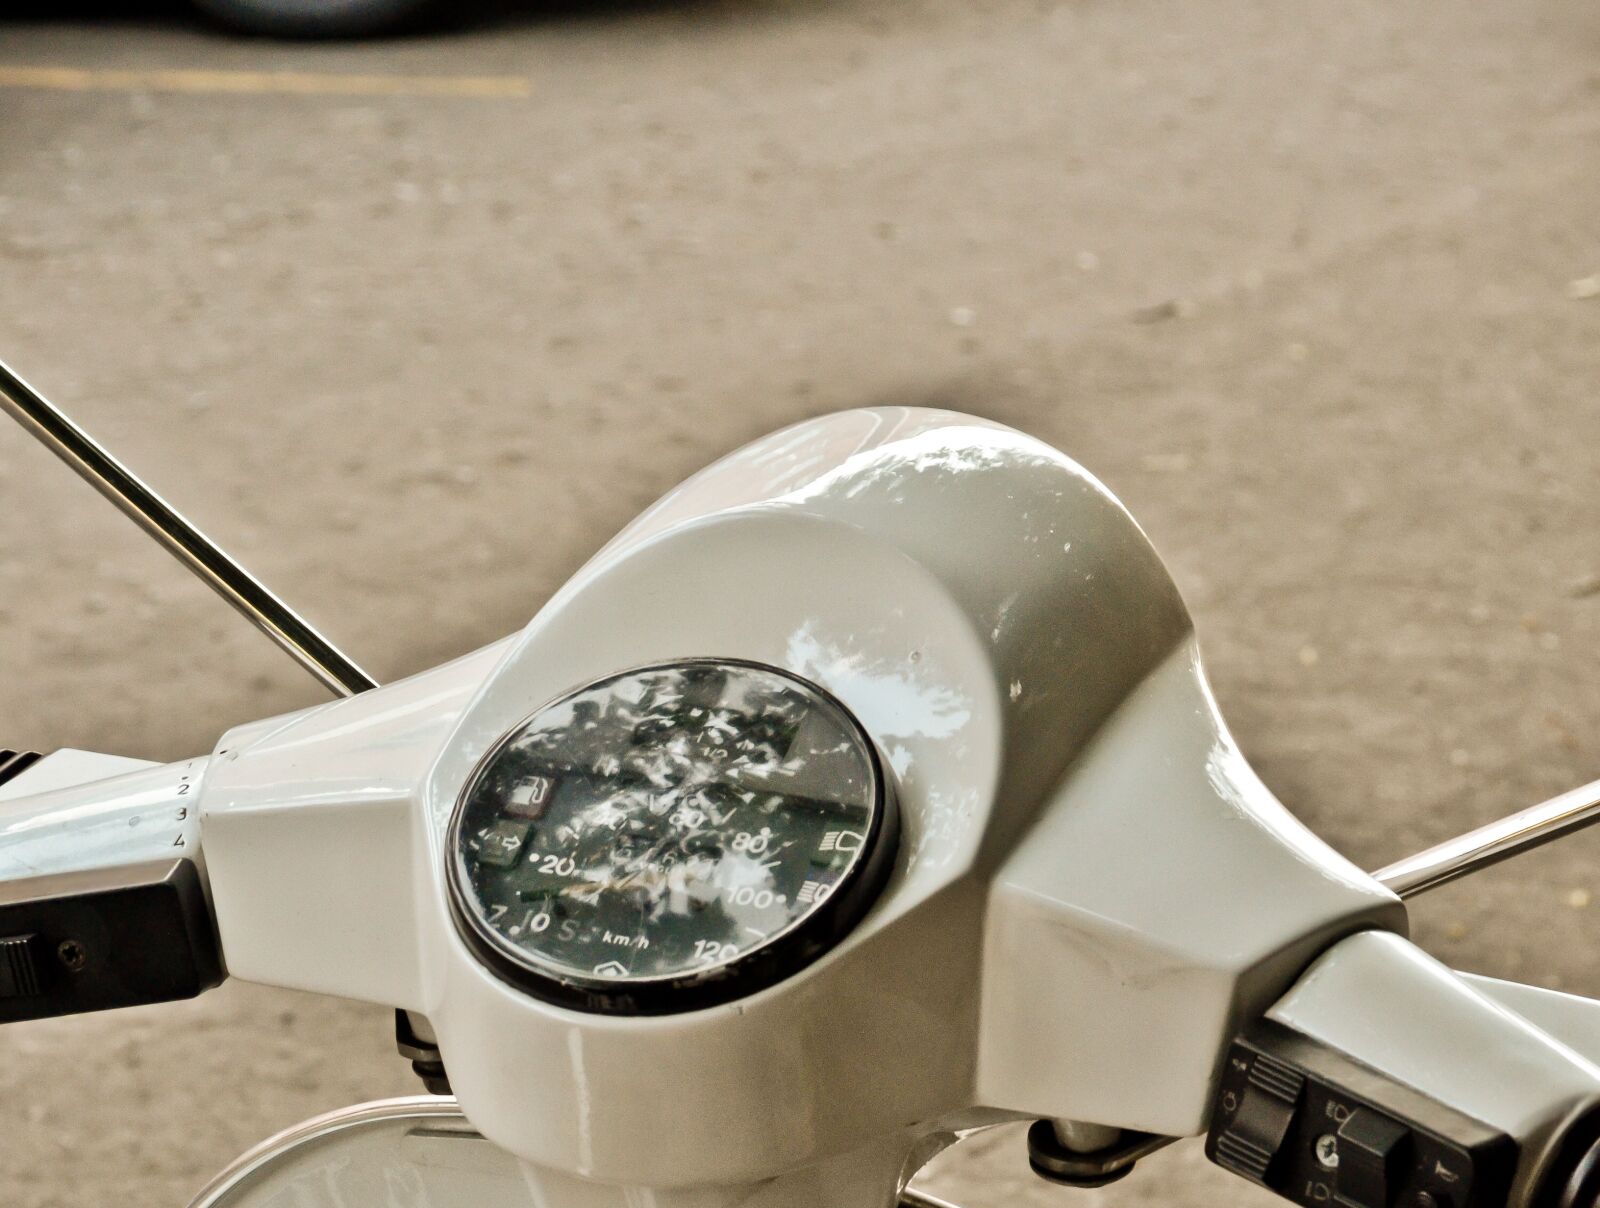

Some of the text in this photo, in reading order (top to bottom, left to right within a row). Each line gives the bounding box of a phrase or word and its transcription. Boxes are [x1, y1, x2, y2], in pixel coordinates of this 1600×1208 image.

[177, 783, 190, 796] 2
[176, 807, 188, 821] 3
[173, 832, 186, 848] 4
[731, 831, 769, 854] 80
[537, 854, 576, 877] 20
[725, 886, 774, 909] 100
[601, 930, 650, 950] km/h
[693, 938, 740, 962] 120
